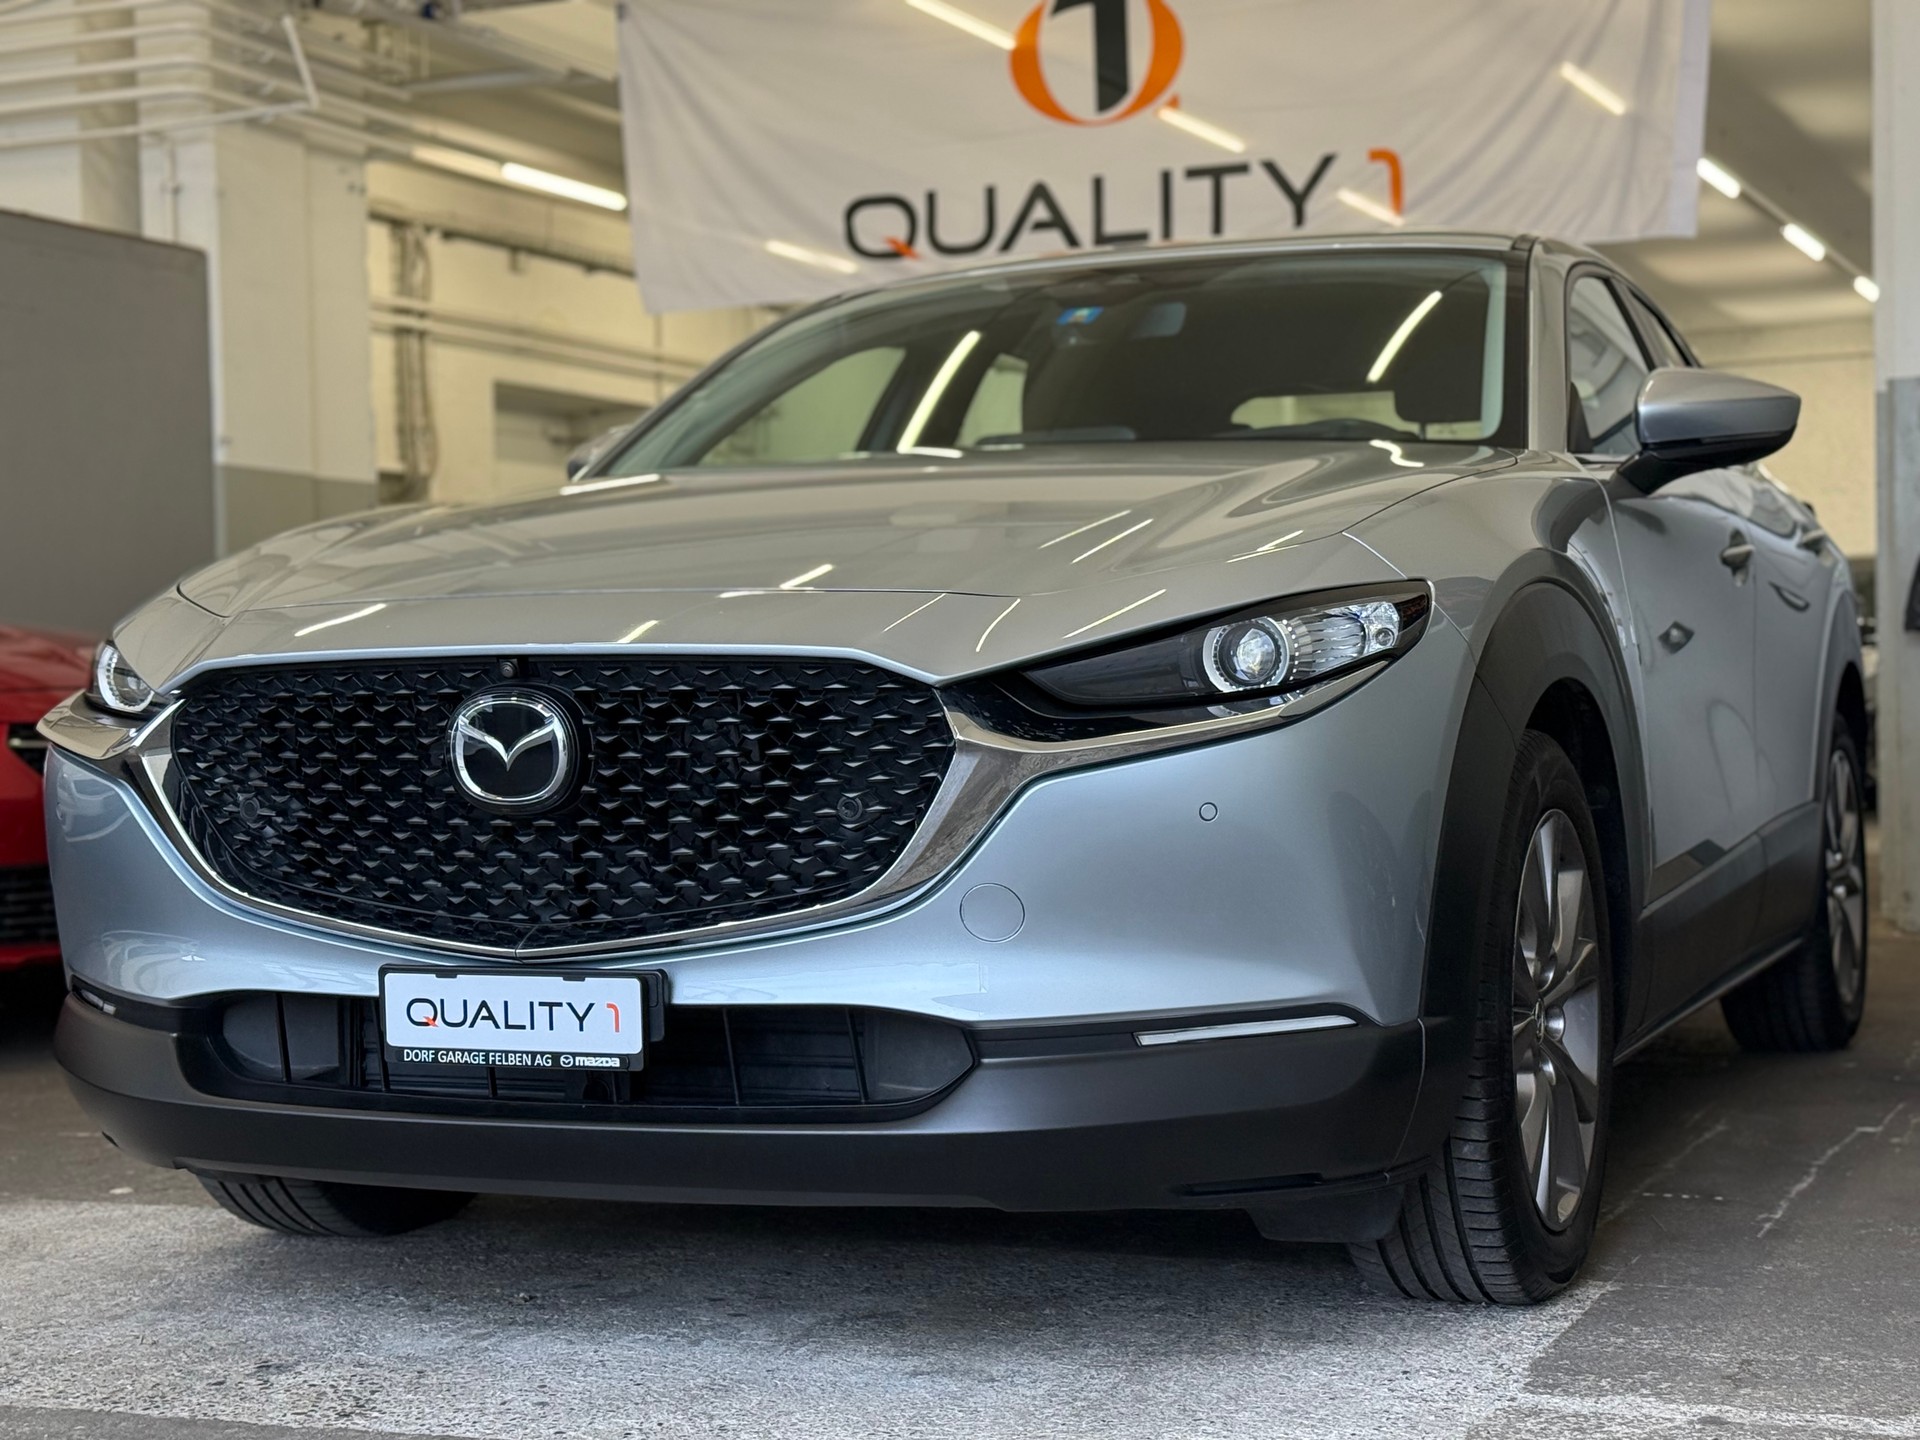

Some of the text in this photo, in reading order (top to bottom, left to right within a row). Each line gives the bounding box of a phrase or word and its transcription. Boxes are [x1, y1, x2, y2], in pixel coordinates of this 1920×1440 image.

[844, 152, 1338, 261] QUALITY
[406, 998, 620, 1033] QUALITY 1
[403, 1049, 435, 1063] DORF
[437, 1051, 486, 1065] GARAGE
[488, 1053, 530, 1066] FELBEN
[534, 1055, 552, 1067] AG
